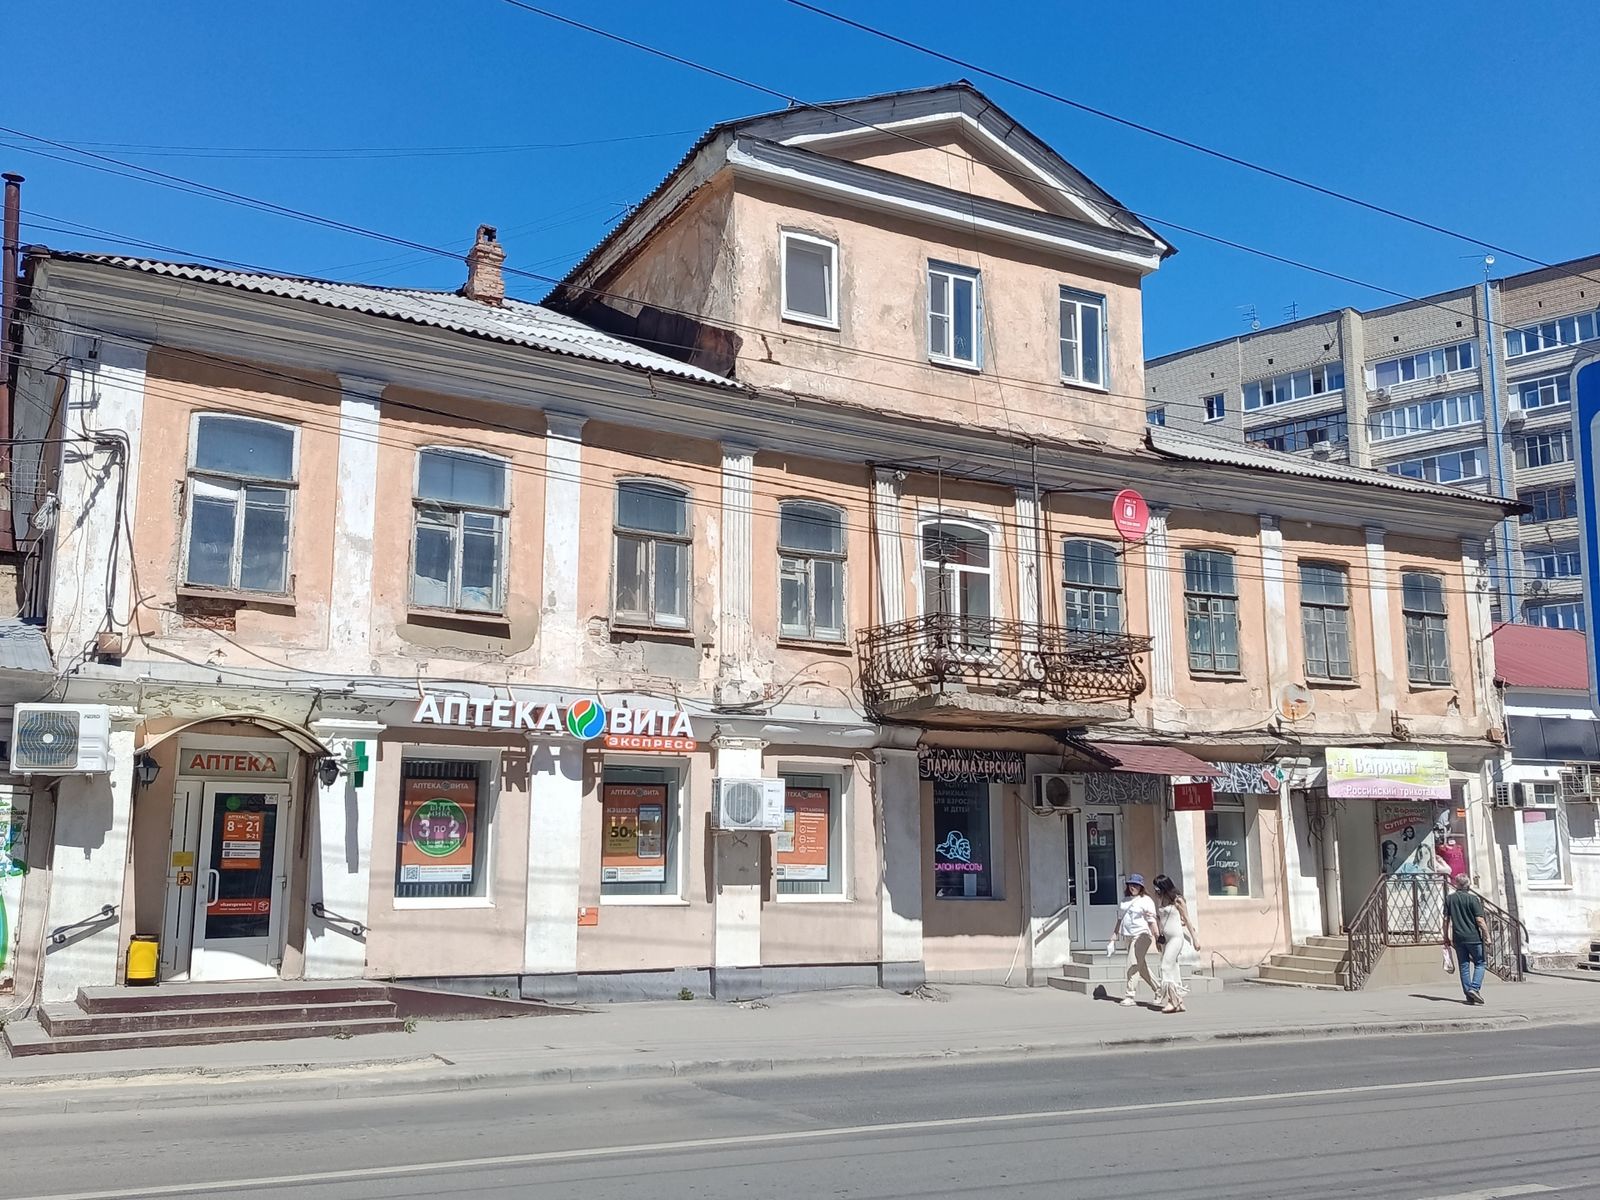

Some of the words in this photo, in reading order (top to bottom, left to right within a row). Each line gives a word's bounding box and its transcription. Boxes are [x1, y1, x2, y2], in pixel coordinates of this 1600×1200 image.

[413, 696, 562, 731] АПТЕКА
[611, 707, 695, 738] ВИТА
[608, 736, 695, 751] ЭКСПРЕСС
[190, 753, 277, 772] АПТЕКА
[927, 759, 1021, 774] ПАРИКМАХЕРСКИЙ
[1355, 759, 1418, 779] Вариант
[413, 782, 441, 790] АПТЕКА
[1346, 785, 1398, 797] Российский
[227, 821, 235, 832] 8
[246, 821, 260, 832] 21
[419, 818, 430, 837] 3
[433, 825, 446, 833] по
[448, 819, 460, 838] 2
[955, 863, 983, 871] КРАСОТЫ
